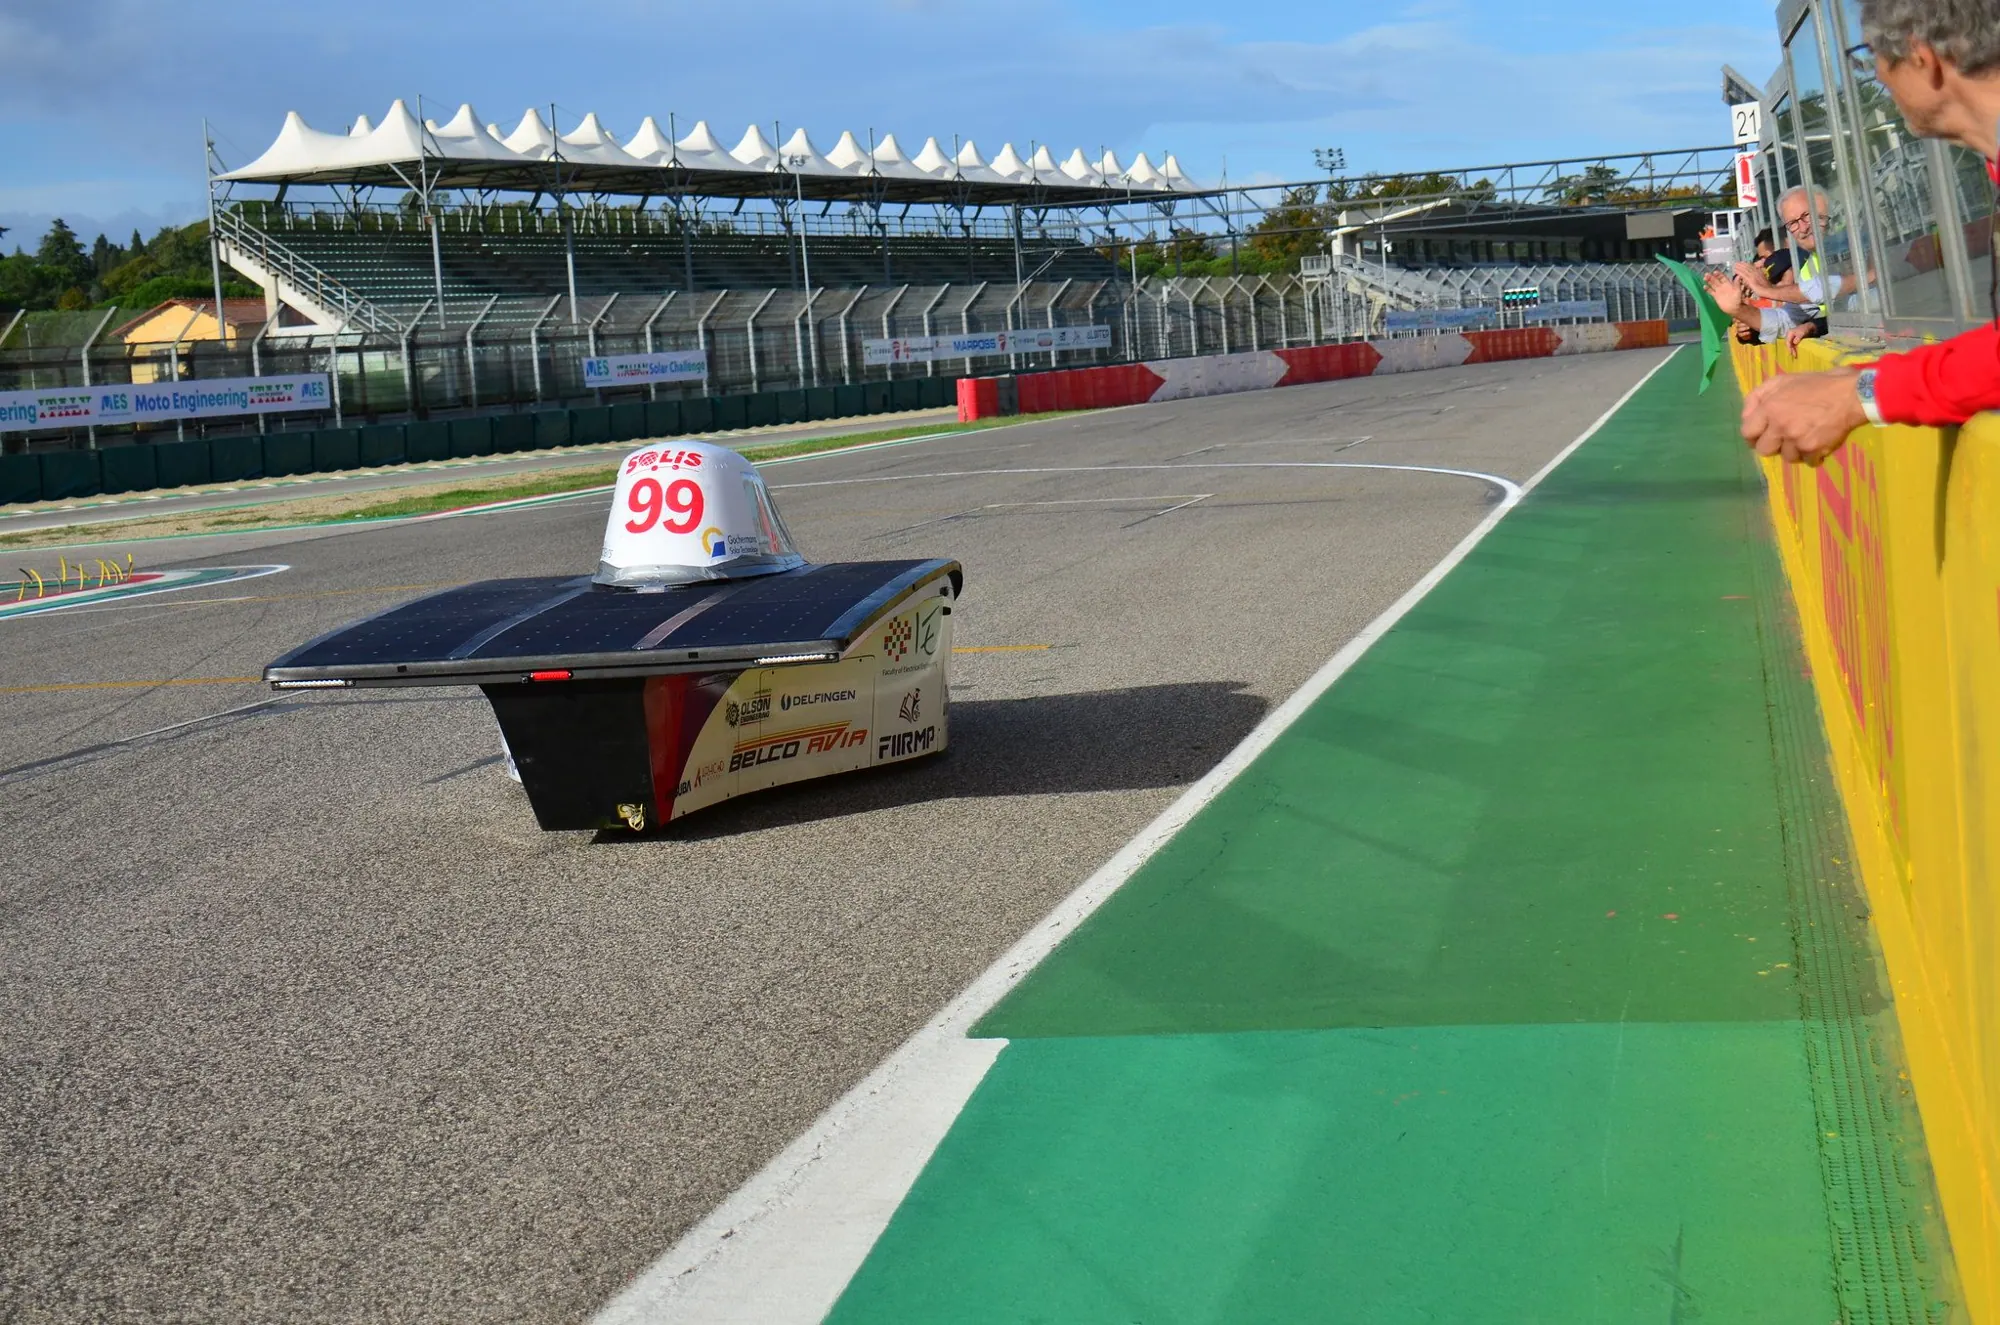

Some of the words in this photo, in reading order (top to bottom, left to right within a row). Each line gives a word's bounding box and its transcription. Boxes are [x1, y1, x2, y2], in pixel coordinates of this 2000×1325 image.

[1736, 109, 1757, 137] 21
[953, 338, 997, 352] MARPOSS
[586, 360, 610, 378] MES
[0, 401, 37, 424] ering
[101, 393, 128, 412] MES
[135, 394, 170, 412] Moto
[173, 387, 248, 413] Engineering
[301, 381, 325, 398] MES
[625, 449, 703, 475] SOLIS
[625, 477, 705, 534] 99
[740, 697, 771, 716] OLSON
[792, 689, 856, 706] DELFINGEN
[806, 728, 868, 756] AVIA
